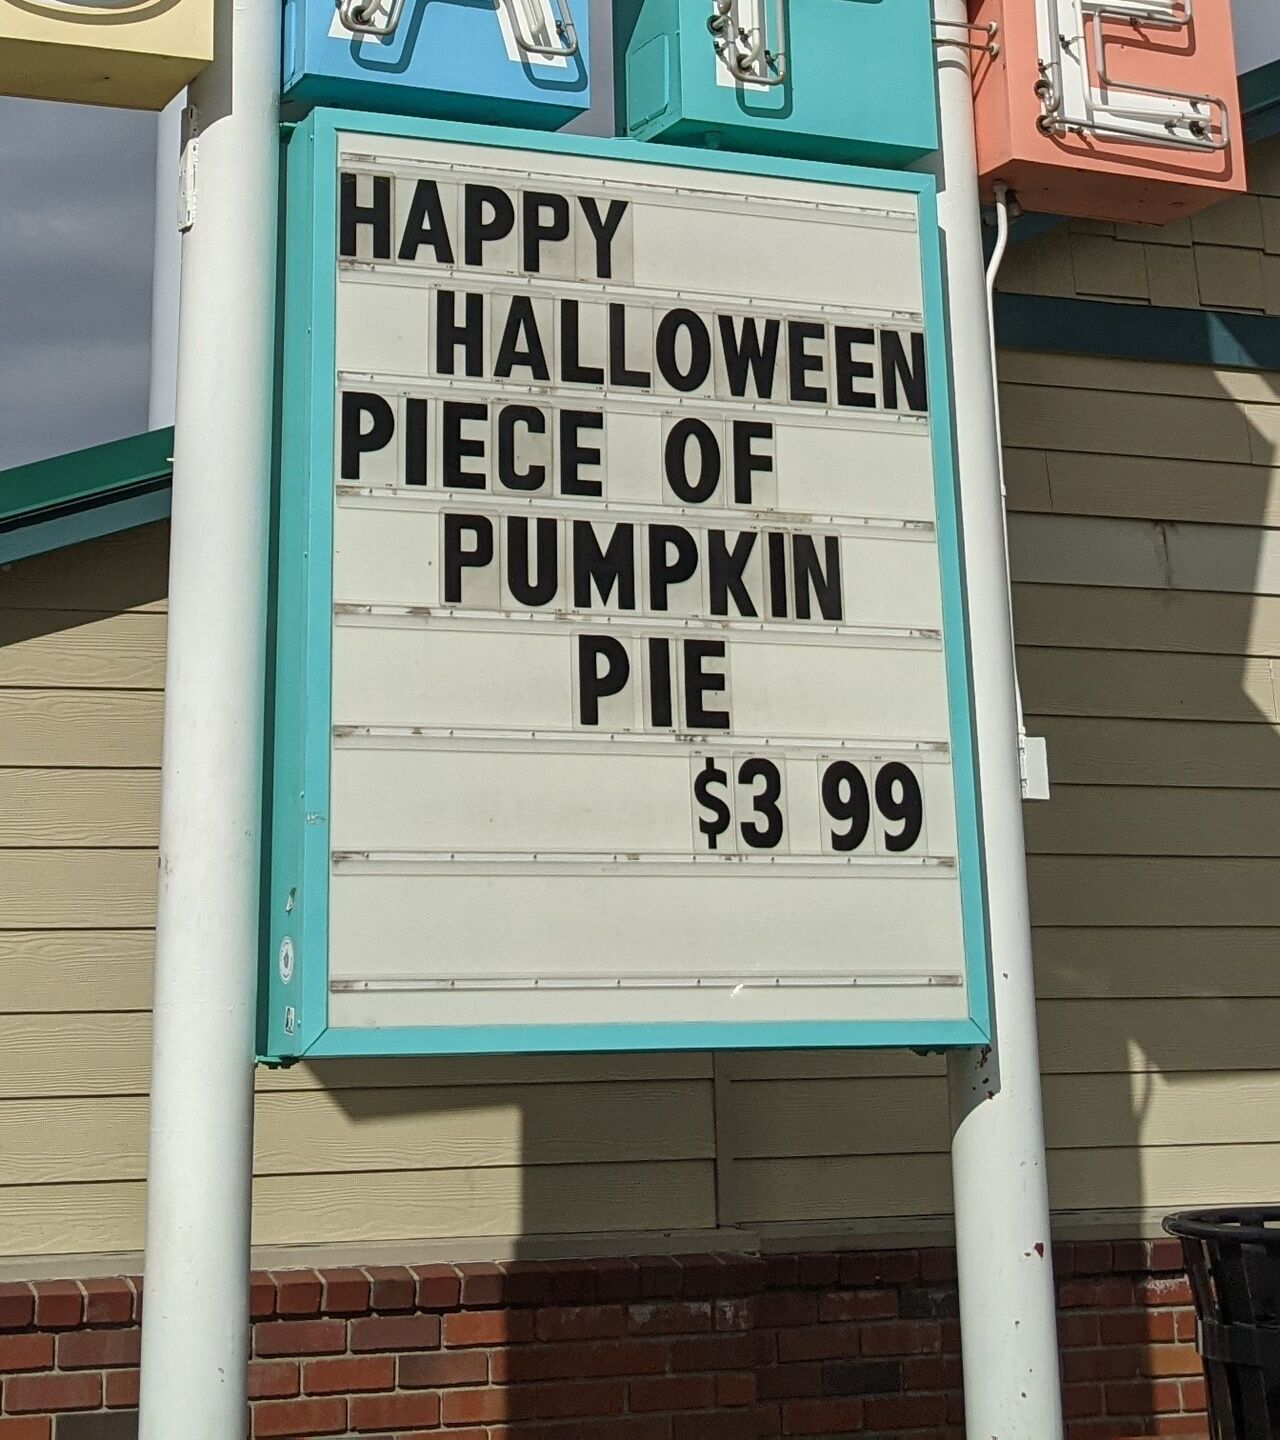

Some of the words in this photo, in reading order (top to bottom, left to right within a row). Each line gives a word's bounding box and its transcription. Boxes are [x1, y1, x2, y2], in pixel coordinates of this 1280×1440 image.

[339, 172, 629, 279] HAPPY
[435, 289, 929, 412] HALLOWEEN
[341, 391, 605, 497] PIECE
[664, 418, 773, 505] OF
[444, 513, 843, 622] PUMPKIN
[578, 634, 731, 730] PIE
